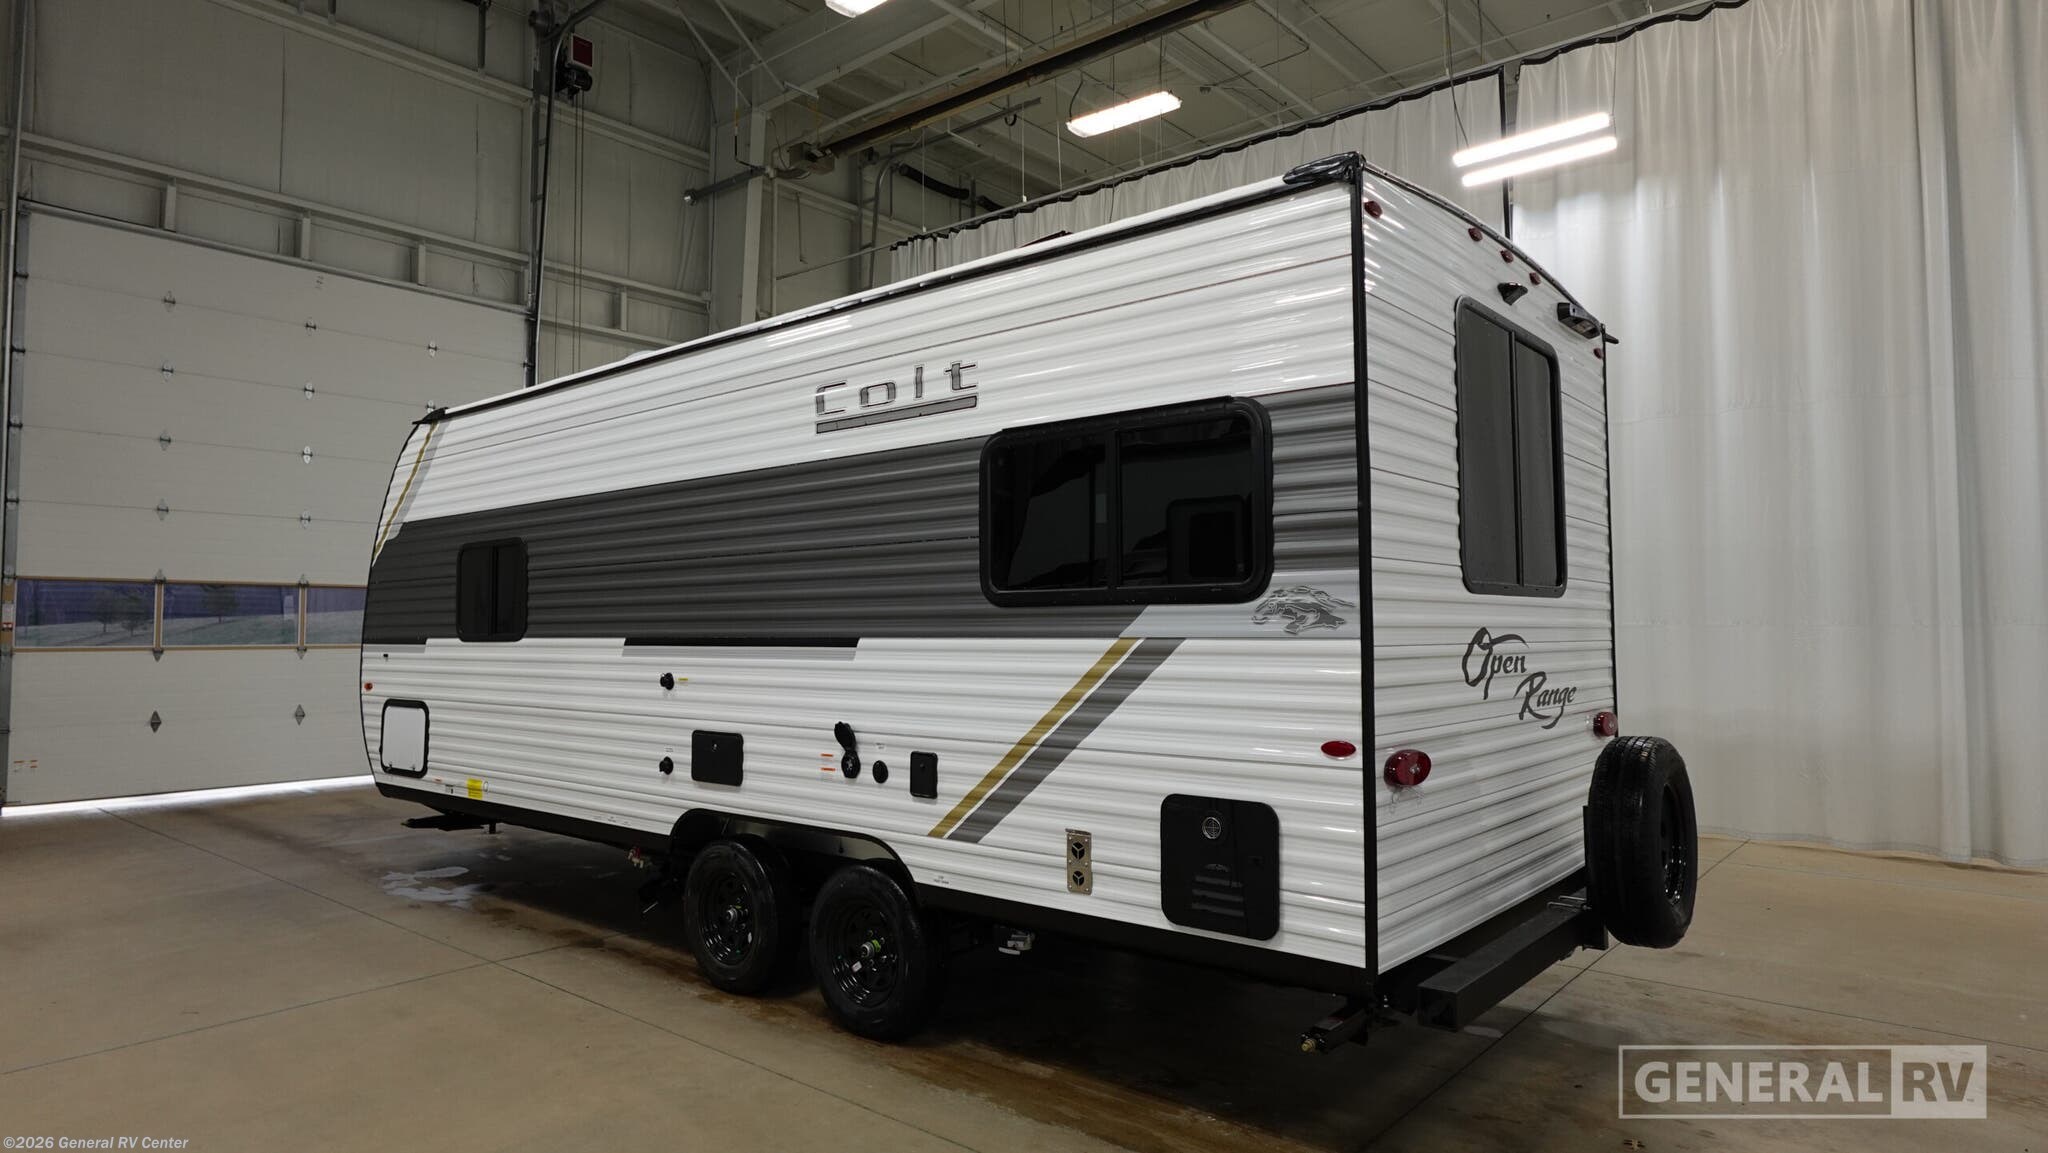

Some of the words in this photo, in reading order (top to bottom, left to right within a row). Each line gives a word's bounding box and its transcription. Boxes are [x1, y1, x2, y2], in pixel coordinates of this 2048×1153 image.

[816, 363, 977, 416] Colt
[1462, 627, 1529, 700] Open
[1513, 671, 1577, 729] Range
